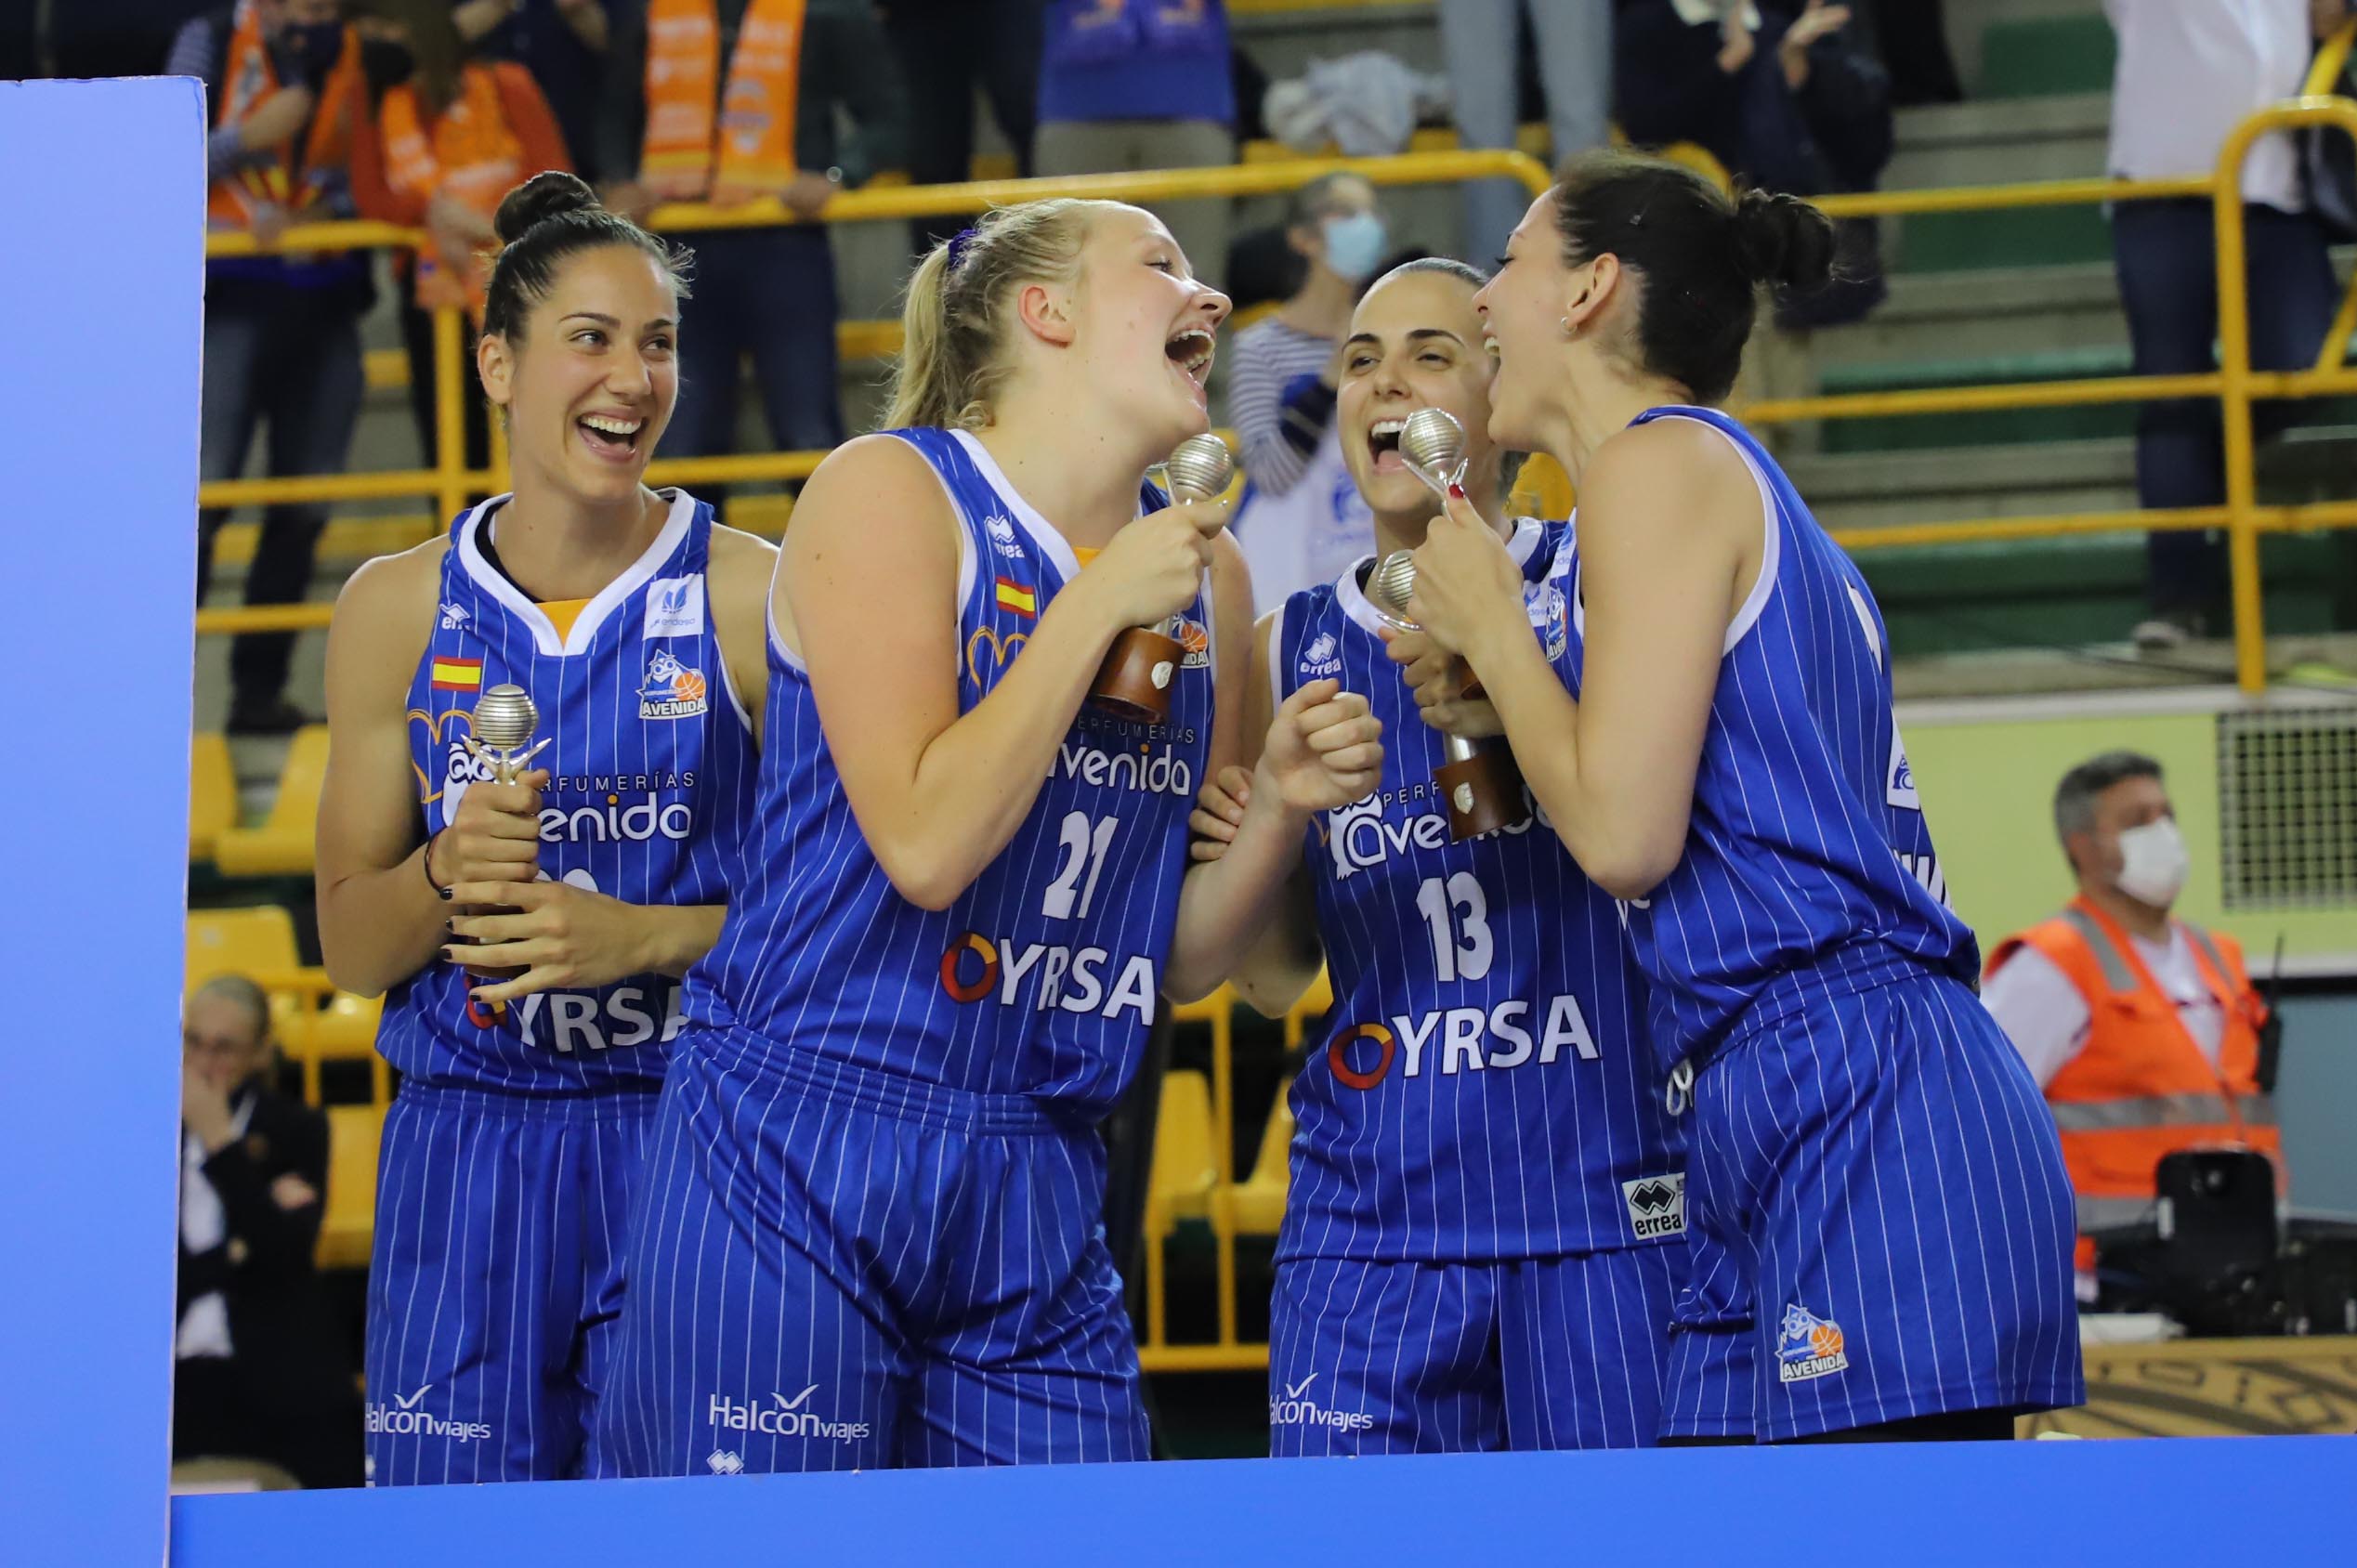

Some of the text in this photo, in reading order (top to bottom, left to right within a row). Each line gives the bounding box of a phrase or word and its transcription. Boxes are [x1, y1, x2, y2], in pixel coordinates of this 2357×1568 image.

[641, 698, 706, 716] AVENIDA
[1047, 743, 1191, 796] venida
[537, 791, 692, 843] enida
[1041, 810, 1120, 920] 21
[1415, 870, 1494, 982] 13
[939, 932, 1156, 1026] OYRSA
[1328, 994, 1599, 1091] OYRSA
[1635, 1214, 1683, 1235] errea
[1783, 1355, 1846, 1379] AVENIDA
